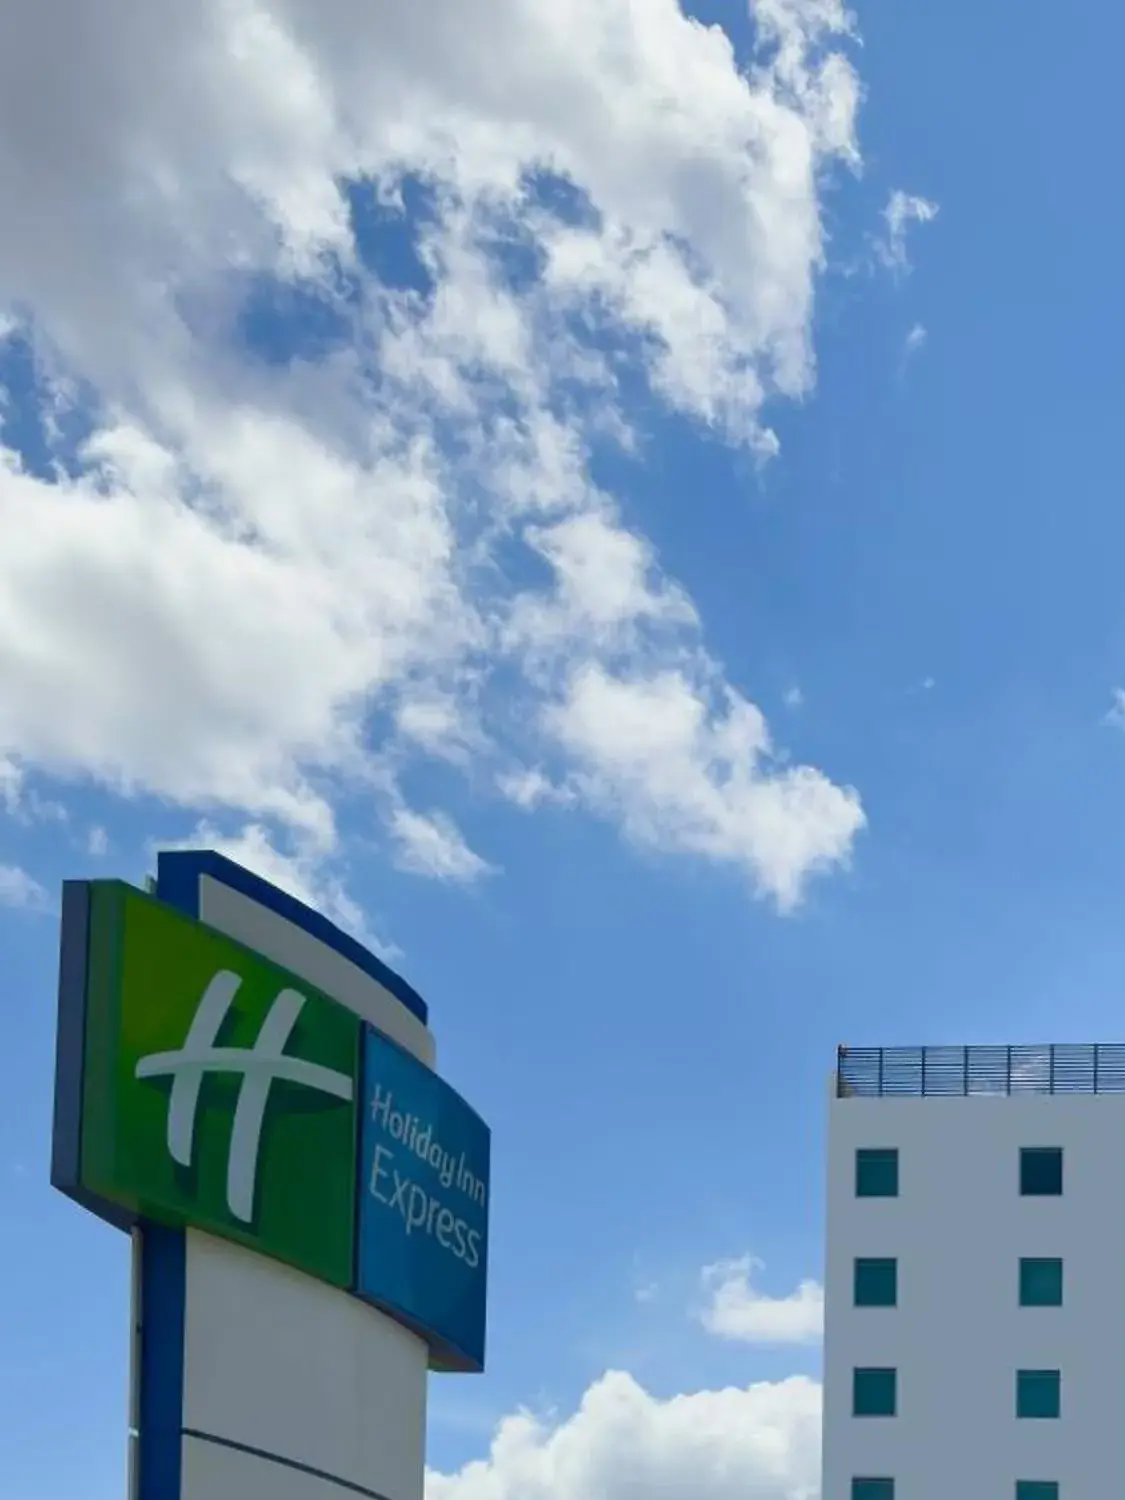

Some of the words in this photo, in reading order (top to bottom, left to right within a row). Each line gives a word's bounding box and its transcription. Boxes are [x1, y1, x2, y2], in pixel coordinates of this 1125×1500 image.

[369, 1083, 456, 1189] Holiday
[456, 1151, 486, 1208] Inn
[369, 1143, 482, 1268] Express
